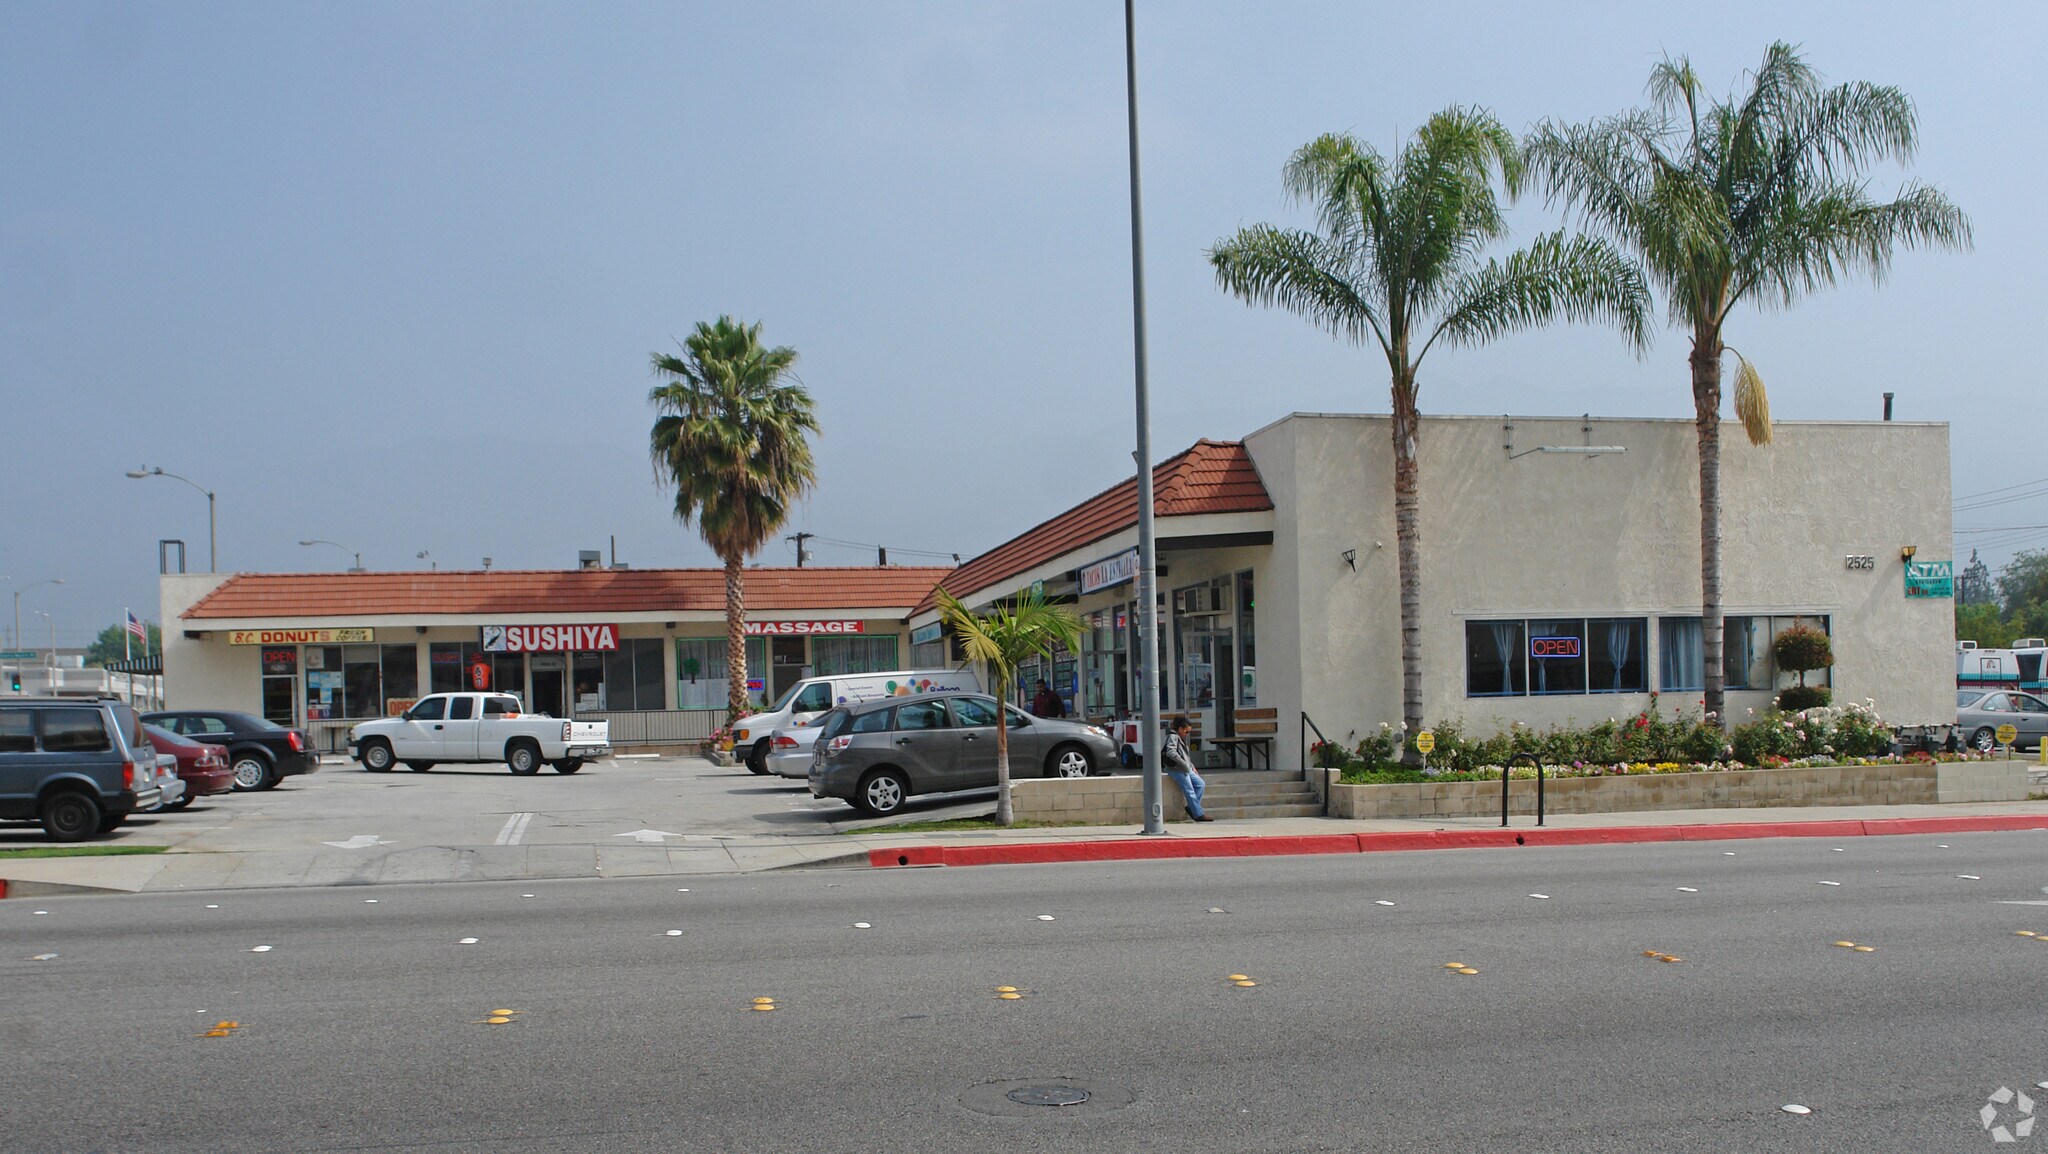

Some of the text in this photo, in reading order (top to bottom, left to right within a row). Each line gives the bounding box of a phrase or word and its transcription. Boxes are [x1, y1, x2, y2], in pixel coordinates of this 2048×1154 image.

[1847, 557, 1875, 570] 2525
[1907, 563, 1951, 577] ATM
[743, 621, 858, 634] MASSAGE
[261, 631, 331, 643] DONUTS
[507, 626, 615, 651] SUSHIYA
[1534, 640, 1578, 655] OPEN
[264, 651, 295, 663] OPEN
